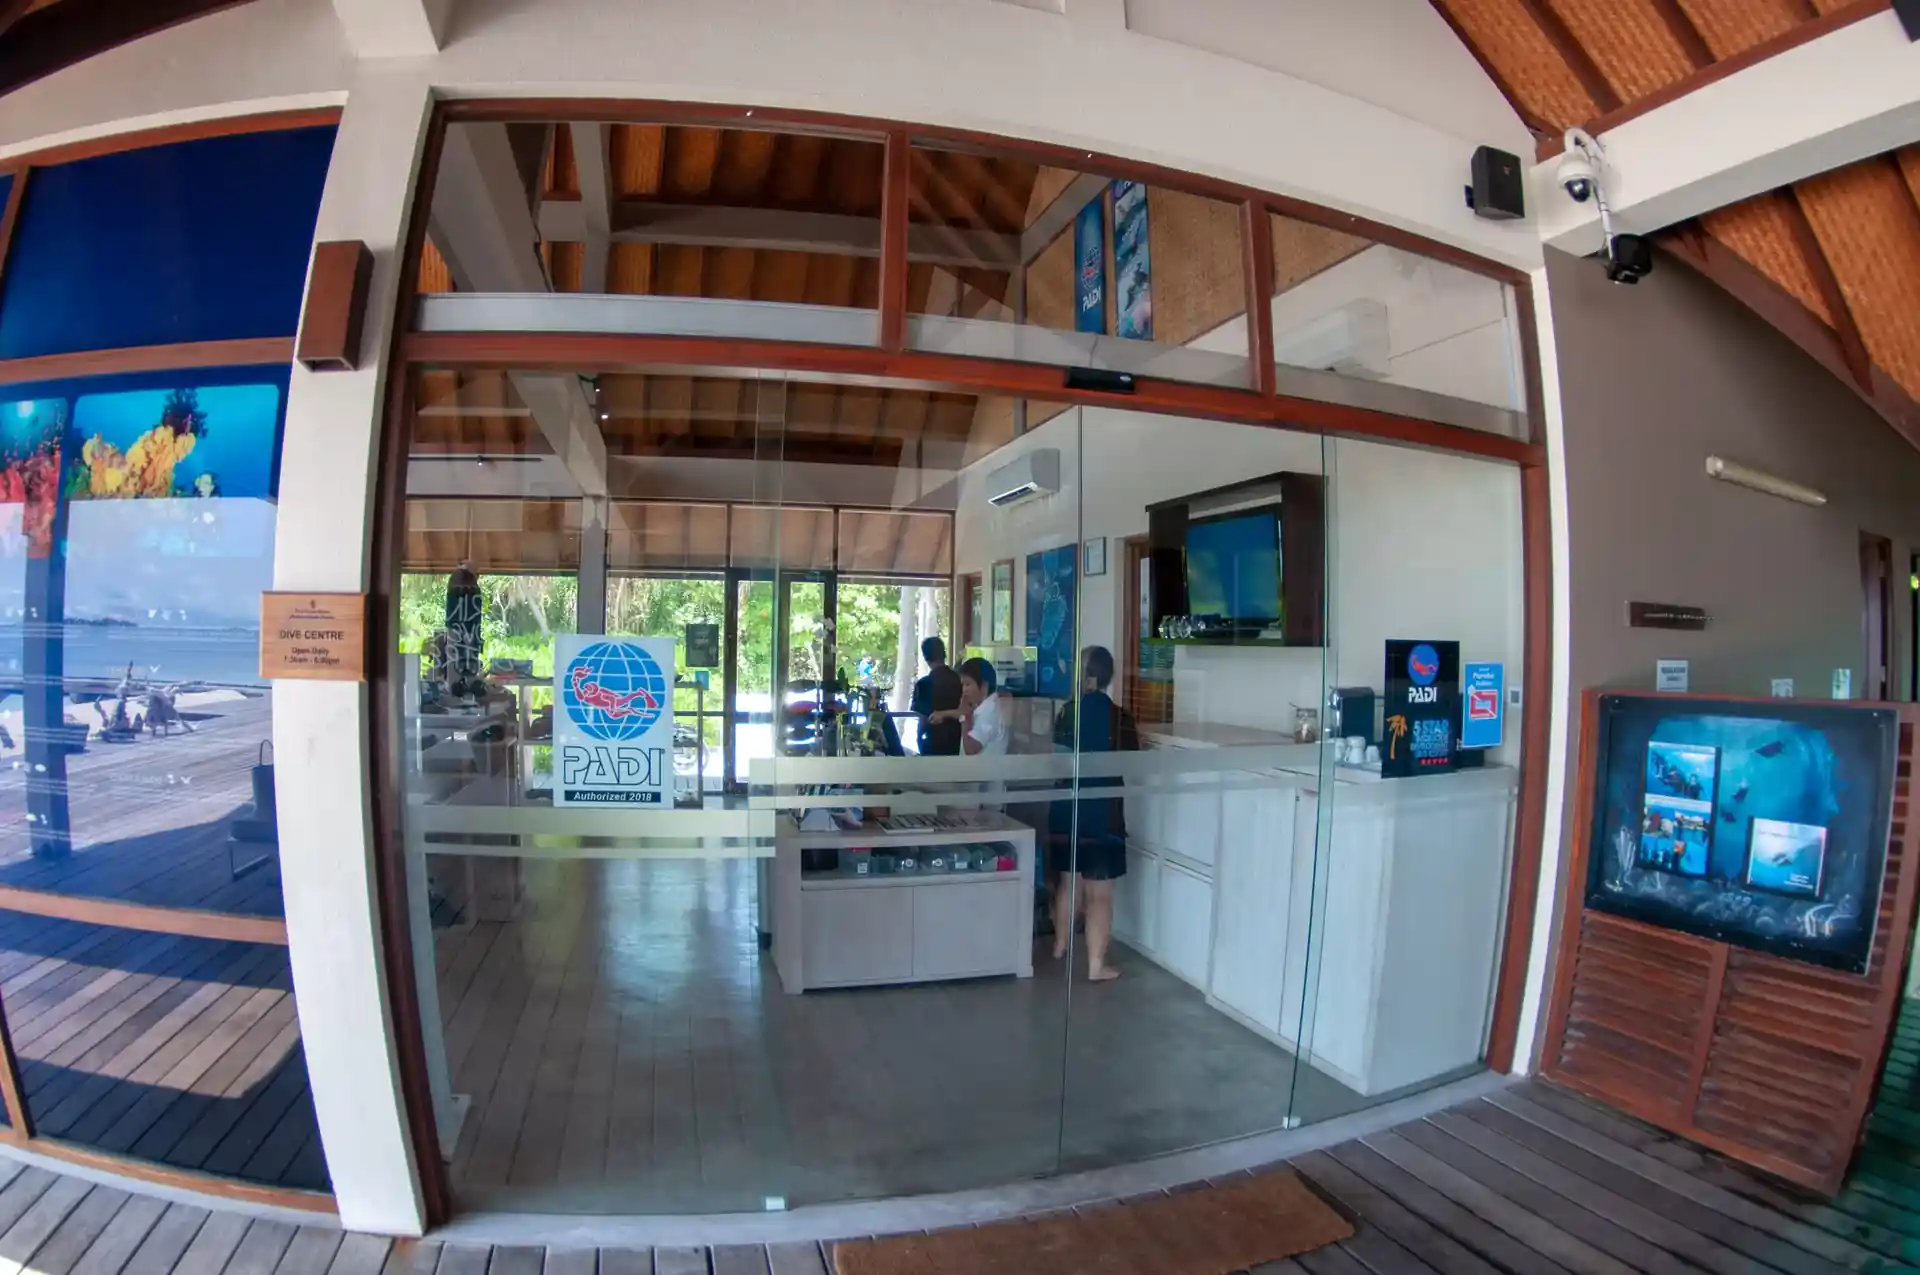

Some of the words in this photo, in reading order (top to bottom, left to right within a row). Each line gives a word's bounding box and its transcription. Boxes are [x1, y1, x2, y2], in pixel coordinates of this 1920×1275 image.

[1082, 286, 1101, 313] PADI
[279, 629, 302, 640] DIVE
[304, 629, 345, 641] CENTRE
[291, 647, 310, 655] Open
[312, 647, 330, 656] Daily
[1408, 686, 1438, 703] PADI
[563, 746, 662, 786] PADI
[573, 790, 627, 801] Authorized
[629, 791, 653, 801] 2018
